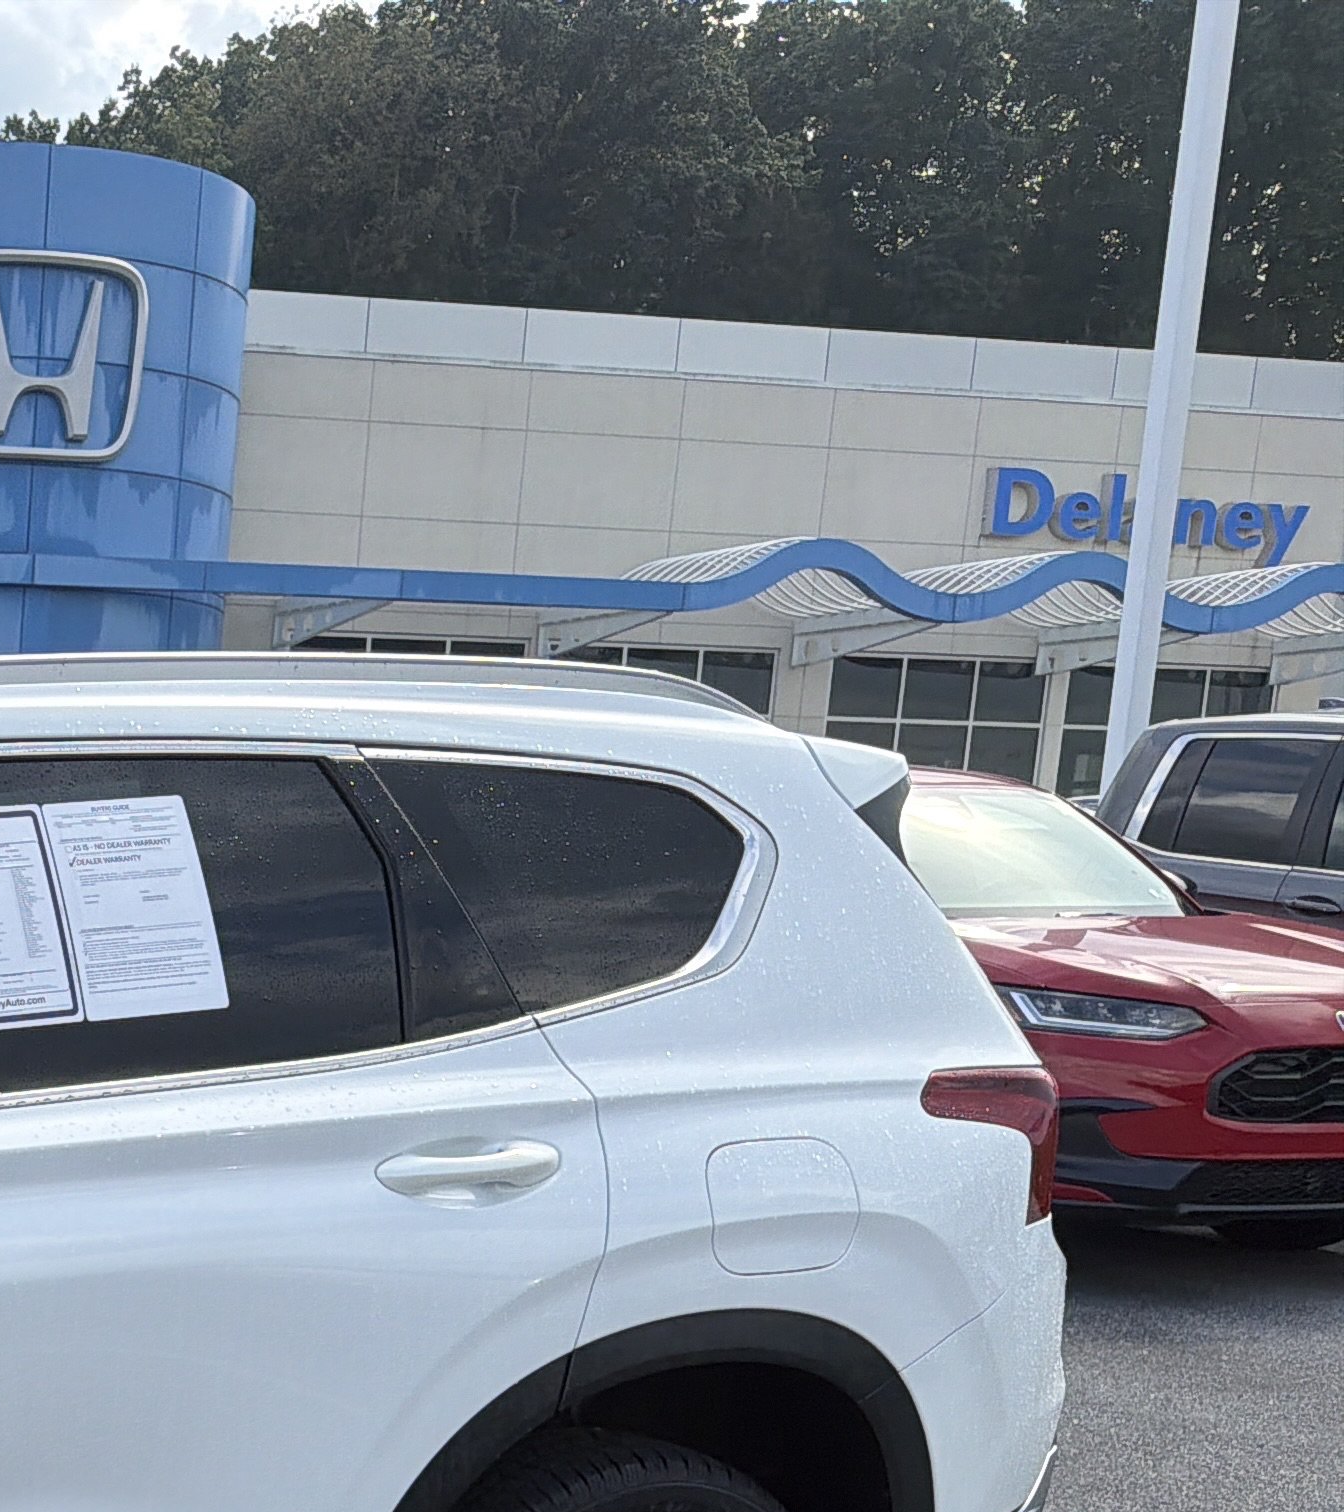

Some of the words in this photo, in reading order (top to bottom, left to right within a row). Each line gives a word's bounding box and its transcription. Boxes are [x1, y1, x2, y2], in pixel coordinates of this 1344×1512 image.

[988, 466, 1311, 567] Delney
[94, 842, 106, 850] NO
[75, 857, 103, 866] DEALER
